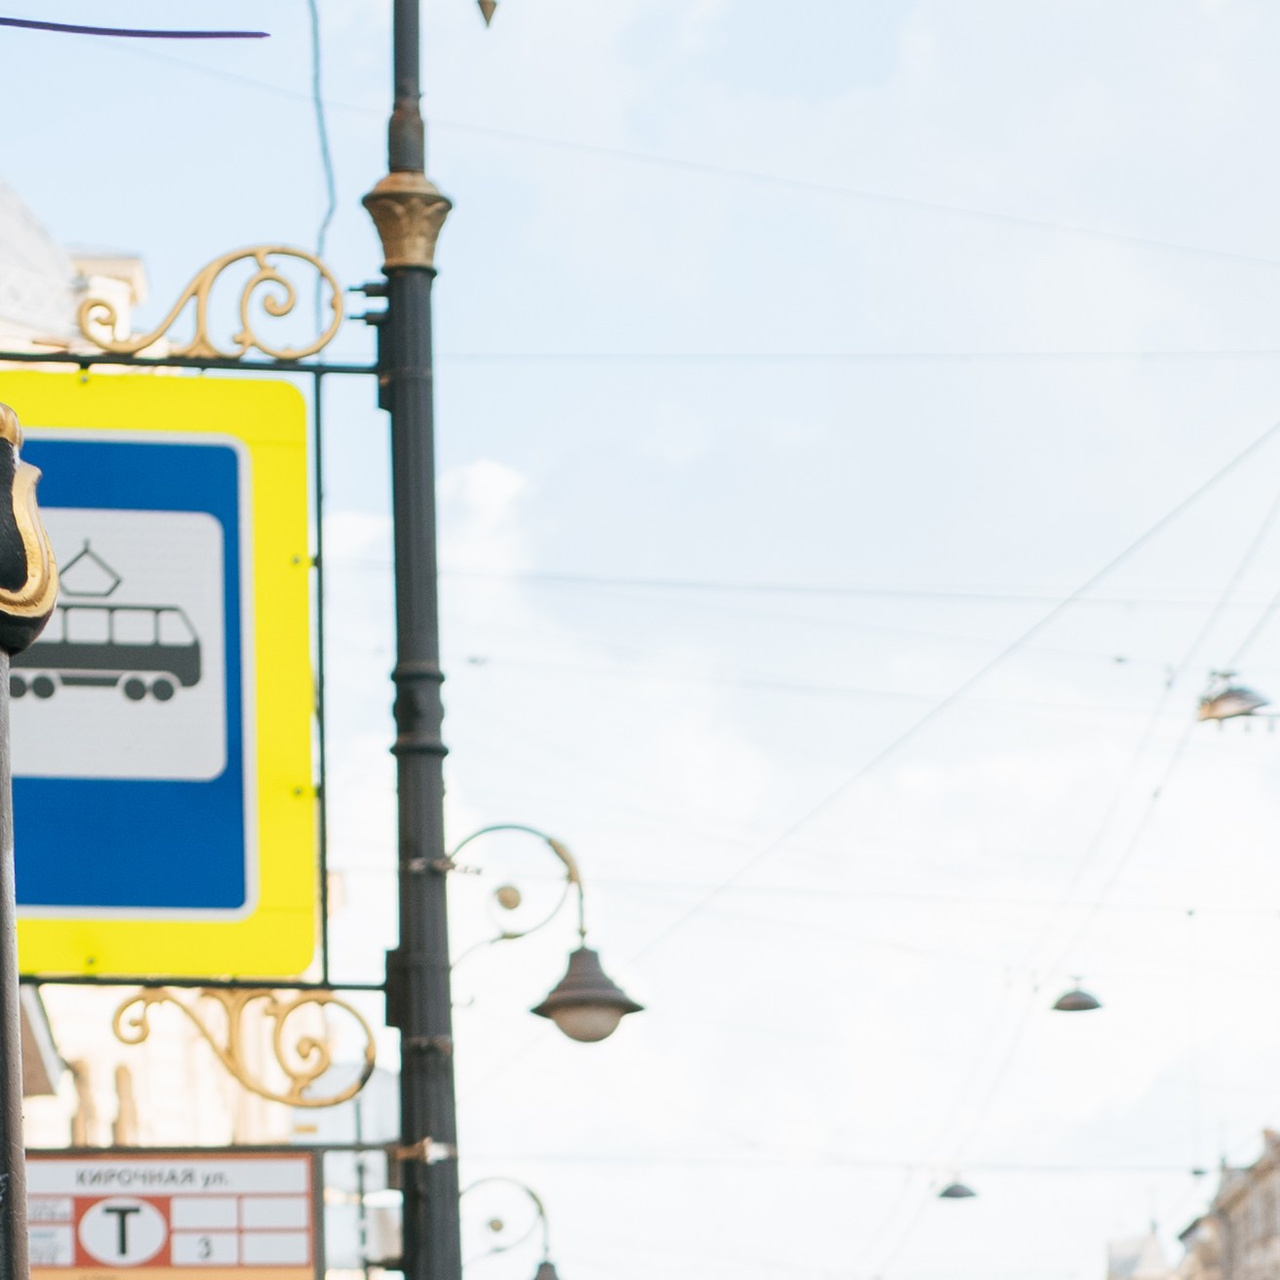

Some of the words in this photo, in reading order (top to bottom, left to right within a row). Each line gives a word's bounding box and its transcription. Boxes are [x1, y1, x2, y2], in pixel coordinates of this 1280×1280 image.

[75, 1168, 196, 1187] КИРОЧНАЯ
[200, 1173, 230, 1188] ул.
[103, 1206, 141, 1256] Т
[198, 1236, 214, 1260] 3
